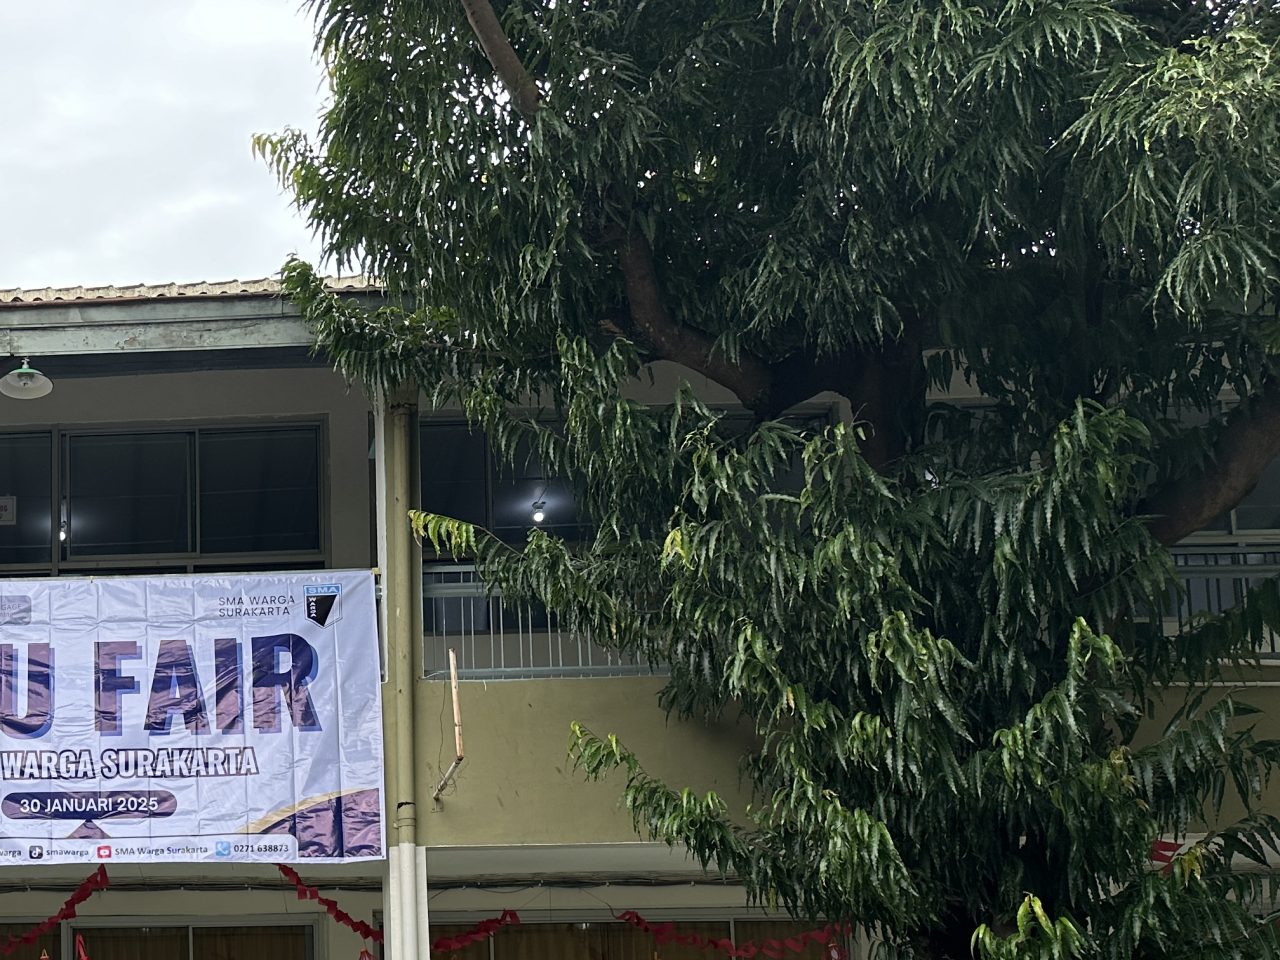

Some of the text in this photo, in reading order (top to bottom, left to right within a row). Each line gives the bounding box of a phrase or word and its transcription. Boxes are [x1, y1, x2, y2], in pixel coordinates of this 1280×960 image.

[308, 586, 338, 594] SMA
[218, 595, 295, 606] SMA WARGA
[219, 606, 291, 617] SURAKARTA
[94, 632, 323, 737] FAIR
[0, 749, 97, 780] WARGA
[99, 746, 260, 778] SURAKARTA
[20, 797, 158, 813] 30 JANUARI 2025
[46, 849, 89, 857] smawarga
[115, 846, 209, 857] SMA Warga Surakarta
[233, 844, 289, 852] 0271 638873
